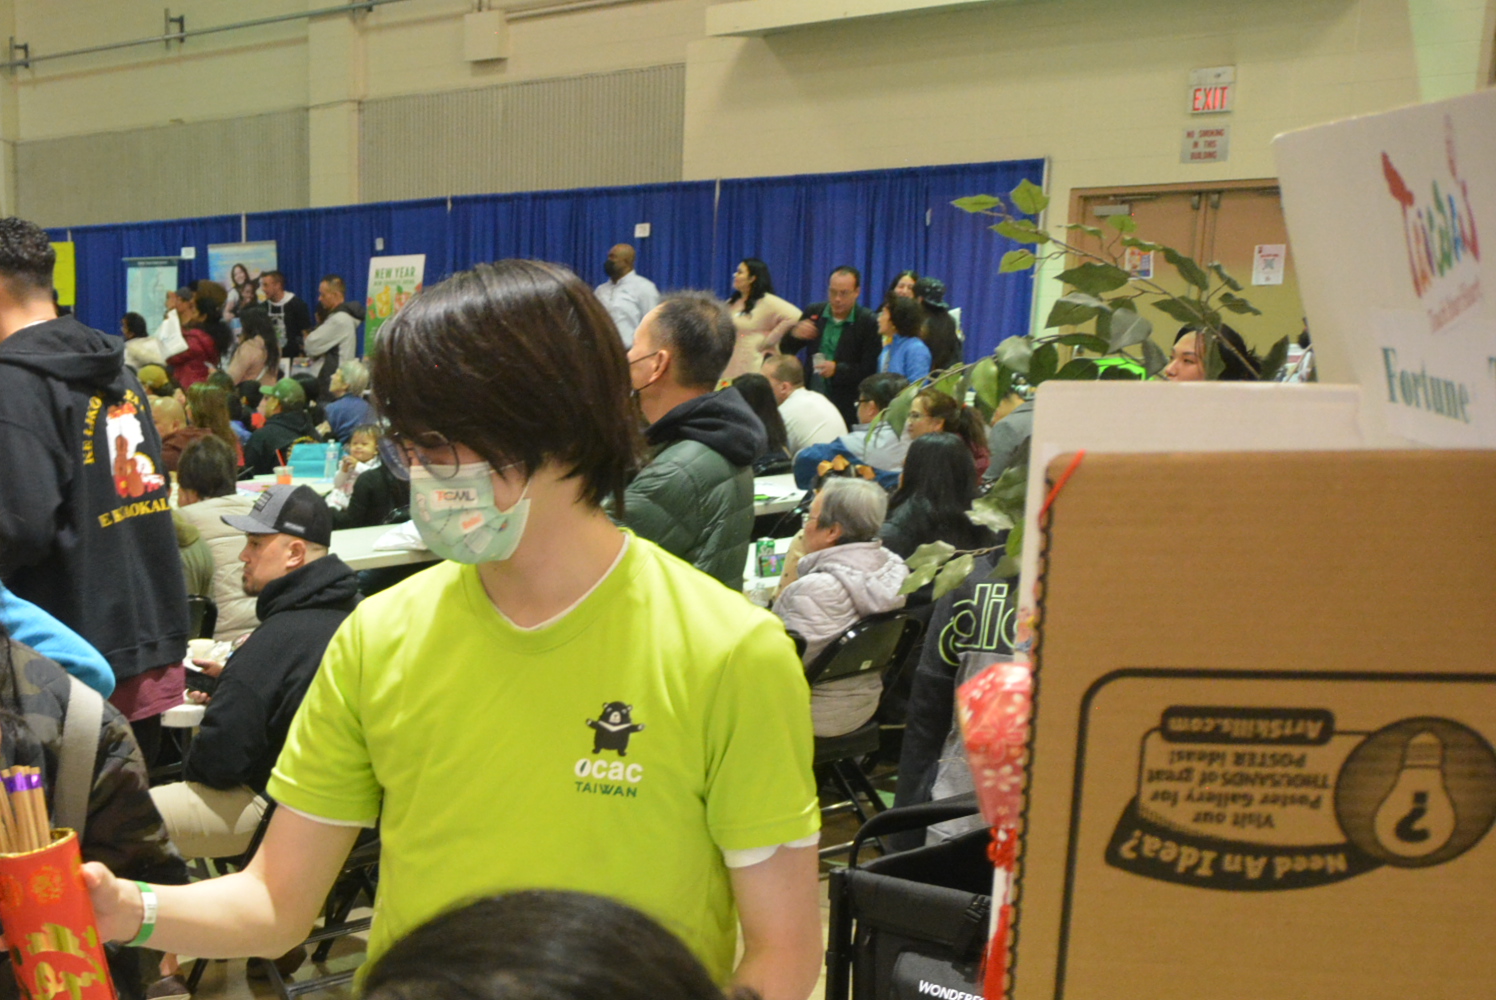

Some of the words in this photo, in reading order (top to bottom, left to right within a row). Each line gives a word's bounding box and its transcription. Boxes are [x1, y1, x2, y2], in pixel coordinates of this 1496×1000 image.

[1192, 86, 1229, 111] EXIT
[374, 268, 392, 279] NEW
[395, 266, 416, 278] YEAR
[1381, 347, 1470, 424] Fortune
[435, 489, 476, 501] TCML
[1167, 717, 1325, 740] ArtSkills.com
[1170, 750, 1226, 766] ideas!
[1234, 752, 1307, 768] POSTER
[574, 758, 644, 783] ocac
[1147, 767, 1194, 783] great
[1199, 771, 1219, 786] of
[1222, 772, 1329, 789] THOUSANDS
[575, 781, 638, 798] TAIWAN
[1150, 789, 1180, 807] for
[1186, 789, 1254, 808] Gallery
[1260, 793, 1322, 810] Poster
[1193, 811, 1226, 824] our
[1233, 813, 1275, 829] Visit
[1119, 829, 1218, 877] Idea?
[1223, 853, 1267, 879] An
[1274, 852, 1348, 879] Need
